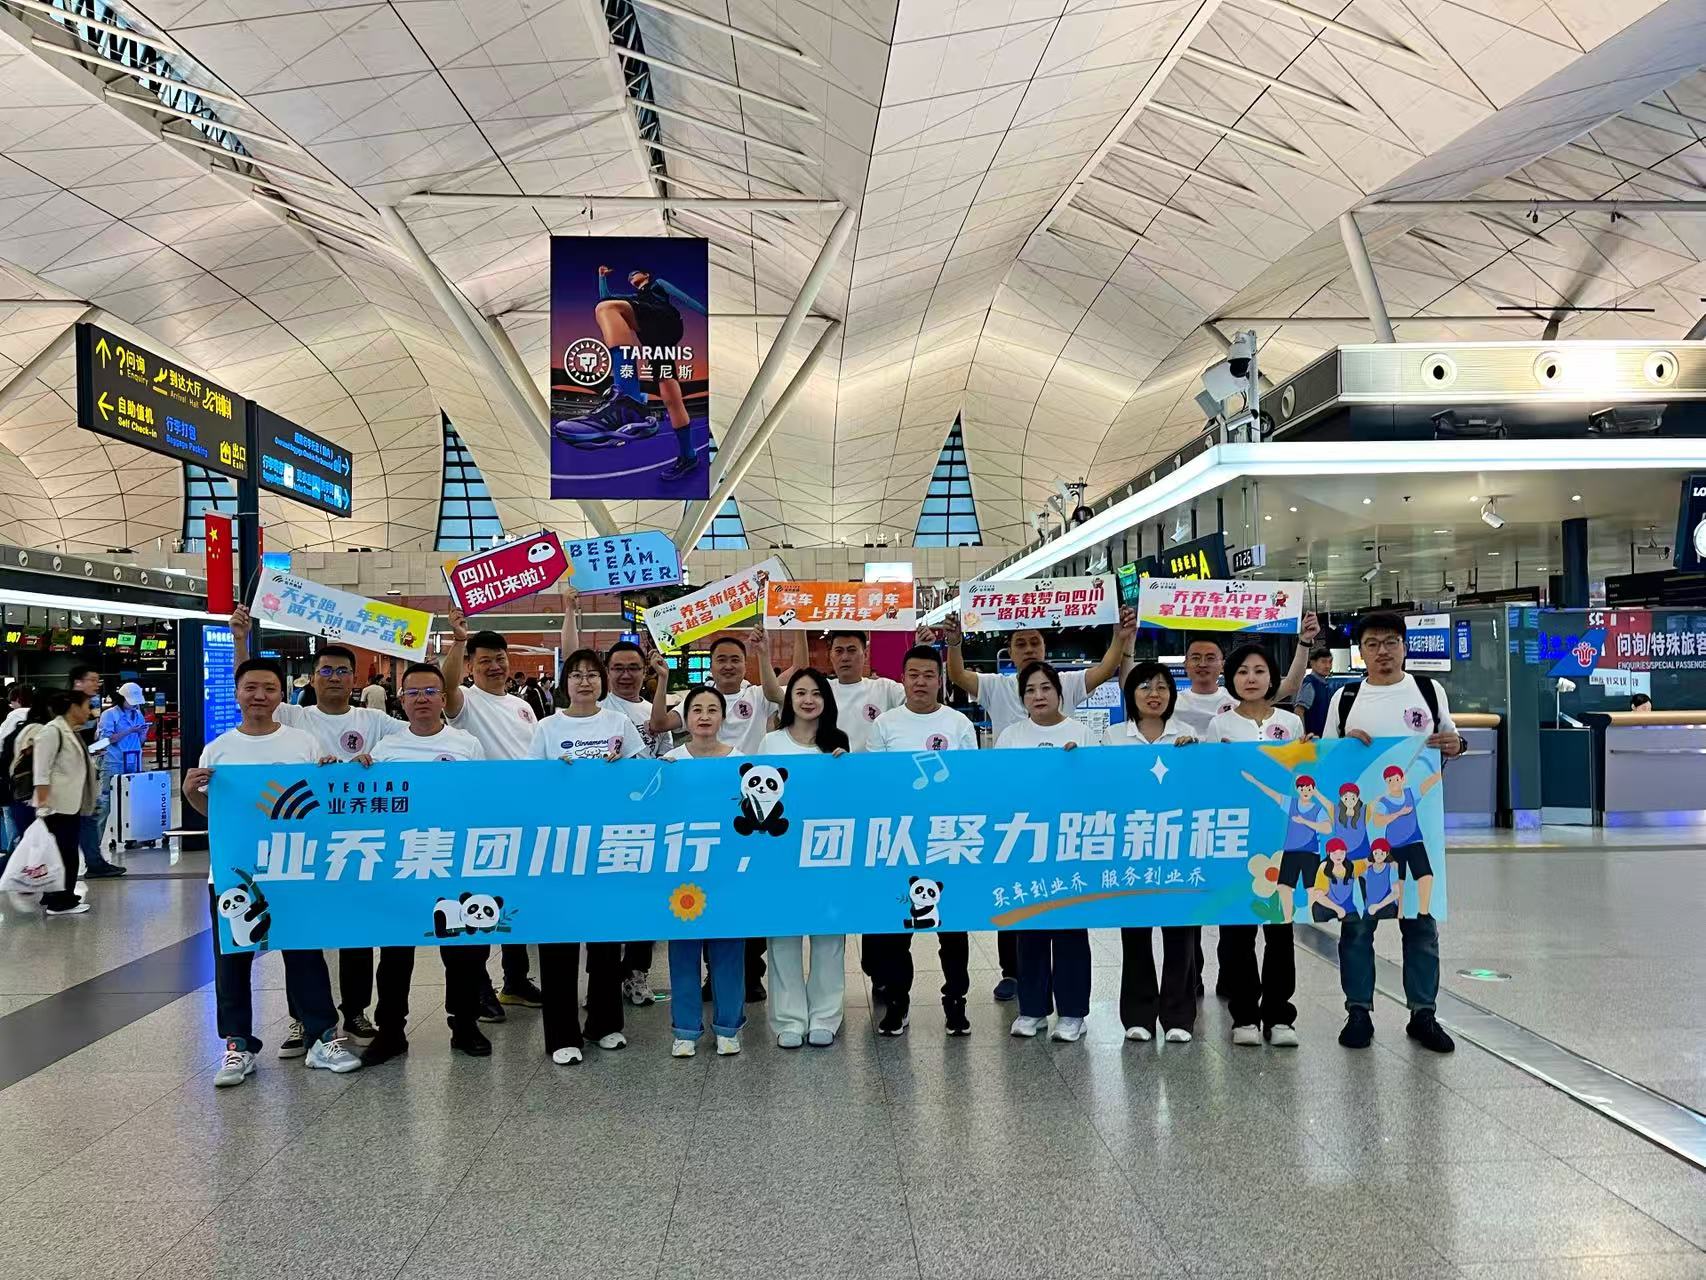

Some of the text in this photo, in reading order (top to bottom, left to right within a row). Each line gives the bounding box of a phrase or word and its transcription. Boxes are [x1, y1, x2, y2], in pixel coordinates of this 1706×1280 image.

[126, 350, 146, 375] 问询
[619, 346, 693, 360] TARANIS
[620, 364, 692, 379] 泰兰尼斯
[169, 369, 202, 398] 到达大厅
[118, 396, 154, 425] 自助值机
[118, 416, 129, 429] Self
[165, 416, 197, 441] 行李打包
[232, 443, 246, 462] 出口
[570, 538, 640, 558] BEST.
[589, 551, 659, 571] TEAM.
[458, 560, 504, 588] 四川，
[608, 566, 677, 586] EVER.
[679, 579, 753, 618] 养车新模式
[782, 592, 814, 606] 买车
[824, 593, 856, 607] 用车
[971, 588, 1104, 608] 乔乔车载梦向四川
[1173, 590, 1268, 604] 乔乔车APP
[807, 606, 873, 620] 上乔乔车
[981, 603, 1098, 621] 一路风光一路欢
[1158, 604, 1280, 620] 掌上智慧车管家
[328, 781, 409, 793] YEQIAO
[328, 796, 409, 814] 业乔集团
[1101, 866, 1206, 889] 服务到业乔
